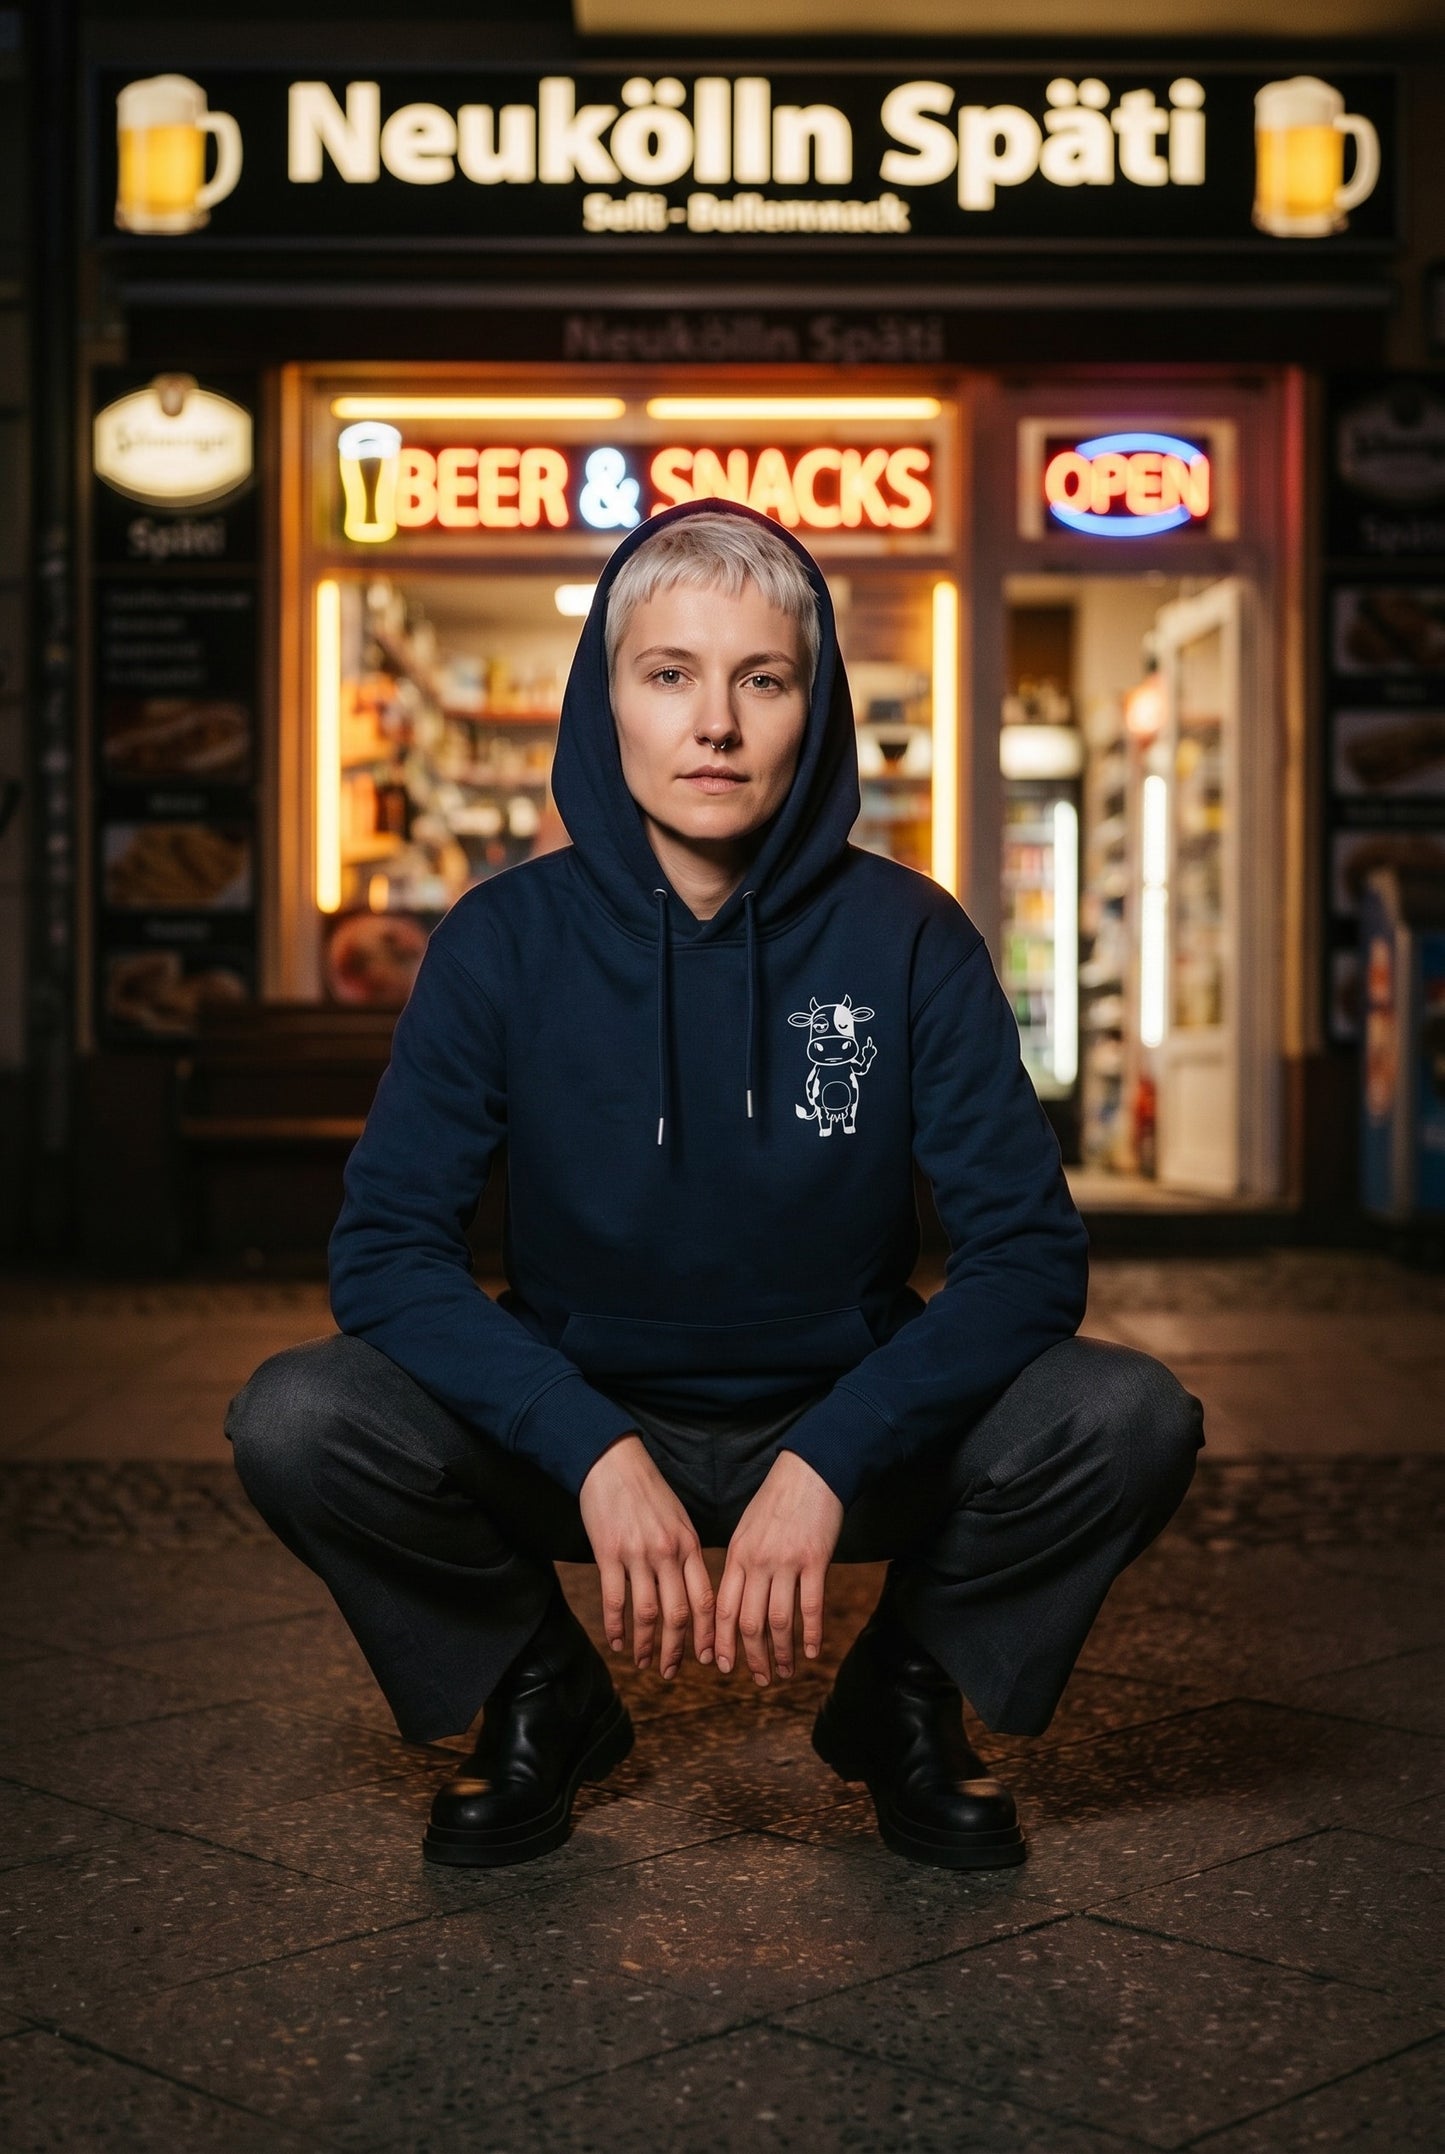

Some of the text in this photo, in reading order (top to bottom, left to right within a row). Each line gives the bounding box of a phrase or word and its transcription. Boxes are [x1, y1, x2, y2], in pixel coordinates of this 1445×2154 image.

[287, 76, 1206, 210] Neukölln Späti
[397, 446, 933, 528] BEER & SNACKS
[1044, 450, 1210, 518] OPEN
